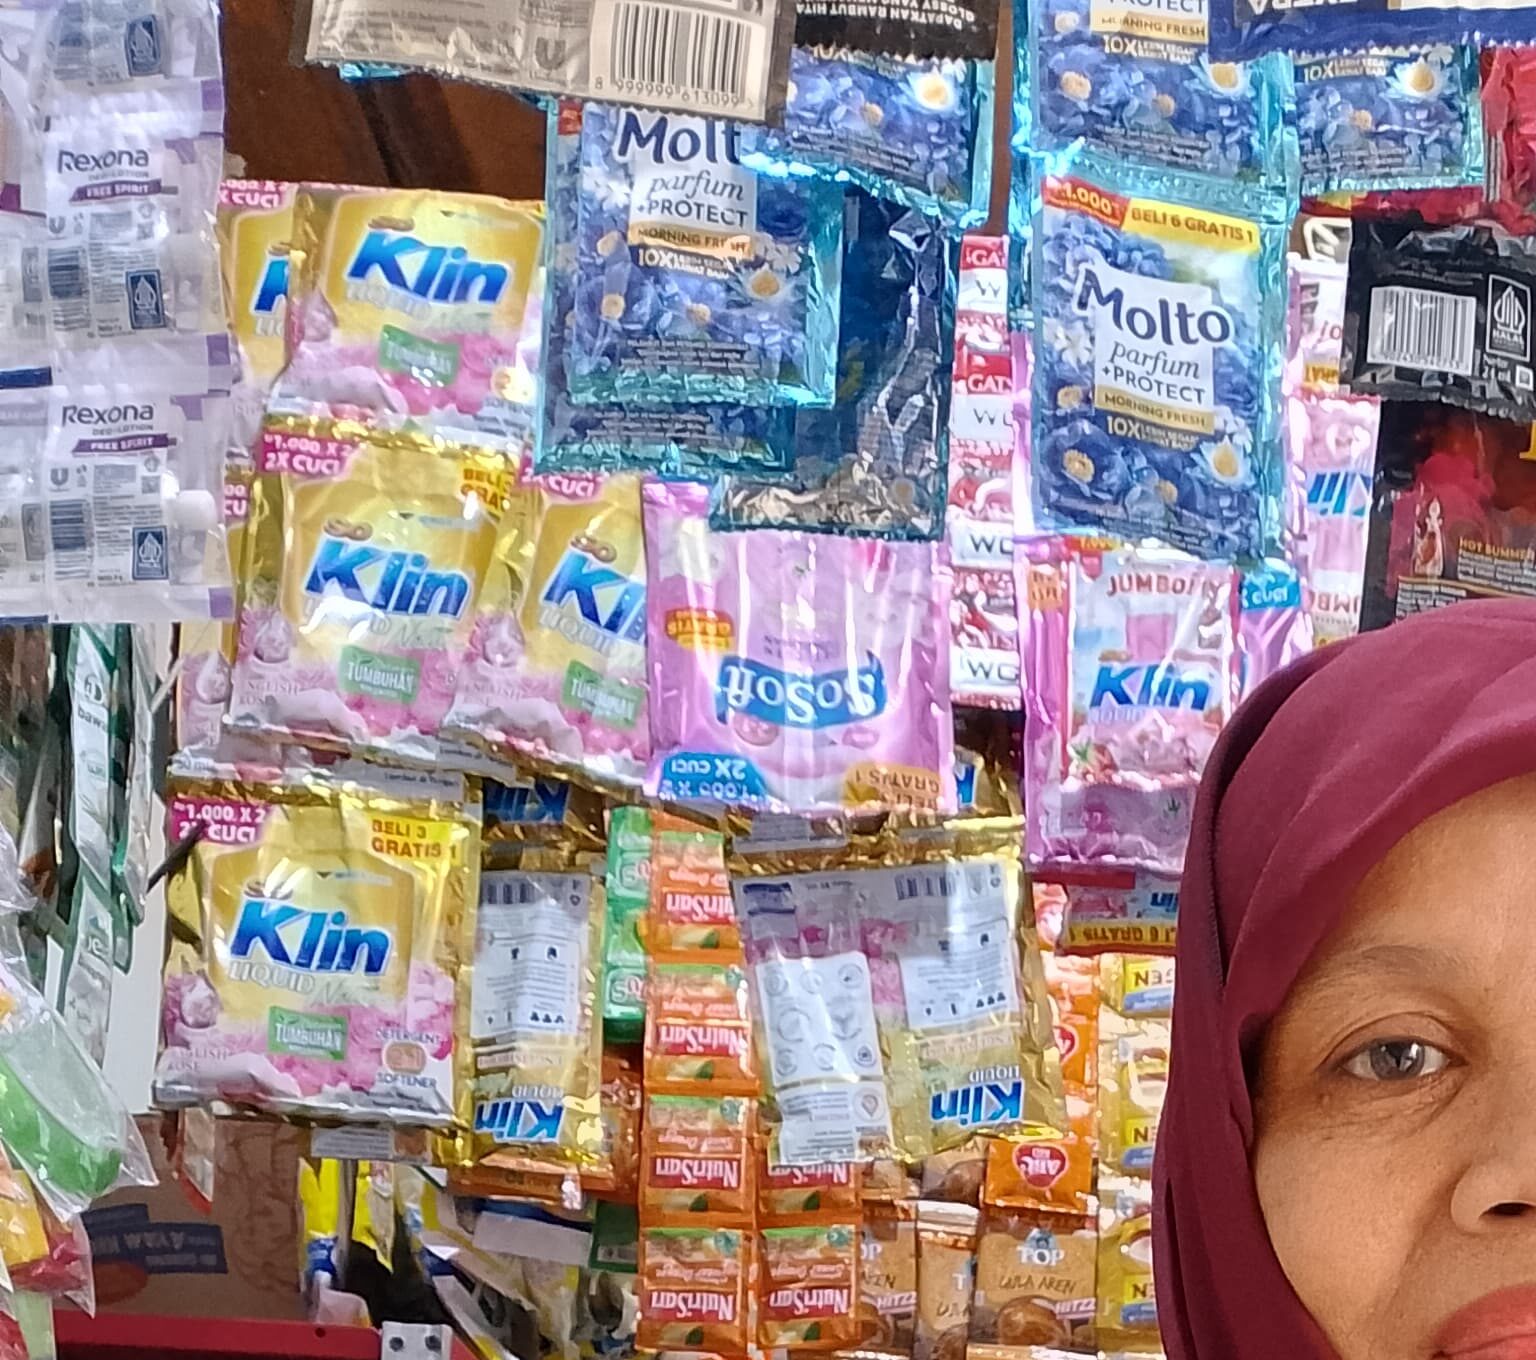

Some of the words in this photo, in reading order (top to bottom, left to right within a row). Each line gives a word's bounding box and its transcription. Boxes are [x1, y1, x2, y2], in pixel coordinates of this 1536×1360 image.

[617, 110, 742, 166] Molt
[58, 149, 149, 174] Rexona
[650, 170, 745, 203] parfum
[1131, 207, 1168, 226] BELI
[1170, 214, 1181, 228] 6
[1185, 216, 1244, 242] GRATIS
[348, 230, 510, 305] Klin
[1076, 266, 1231, 346] Molto
[1110, 341, 1200, 381] parfum
[62, 403, 154, 428] Rexona
[1105, 392, 1164, 421] MORNING
[265, 452, 290, 470] 2X
[292, 454, 341, 475] CUCI
[304, 539, 472, 620] Klin
[1089, 663, 1212, 713] Klin
[207, 824, 257, 843] CUCI
[371, 818, 413, 839] BELI
[371, 837, 442, 859] GRATIS
[228, 898, 392, 975] Klin
[474, 1100, 563, 1140] Klin
[929, 1081, 1023, 1127] Klin
[655, 1157, 739, 1188] NutriSari
[651, 1289, 734, 1322] NutriSari
[769, 1286, 849, 1315] NutriSari
